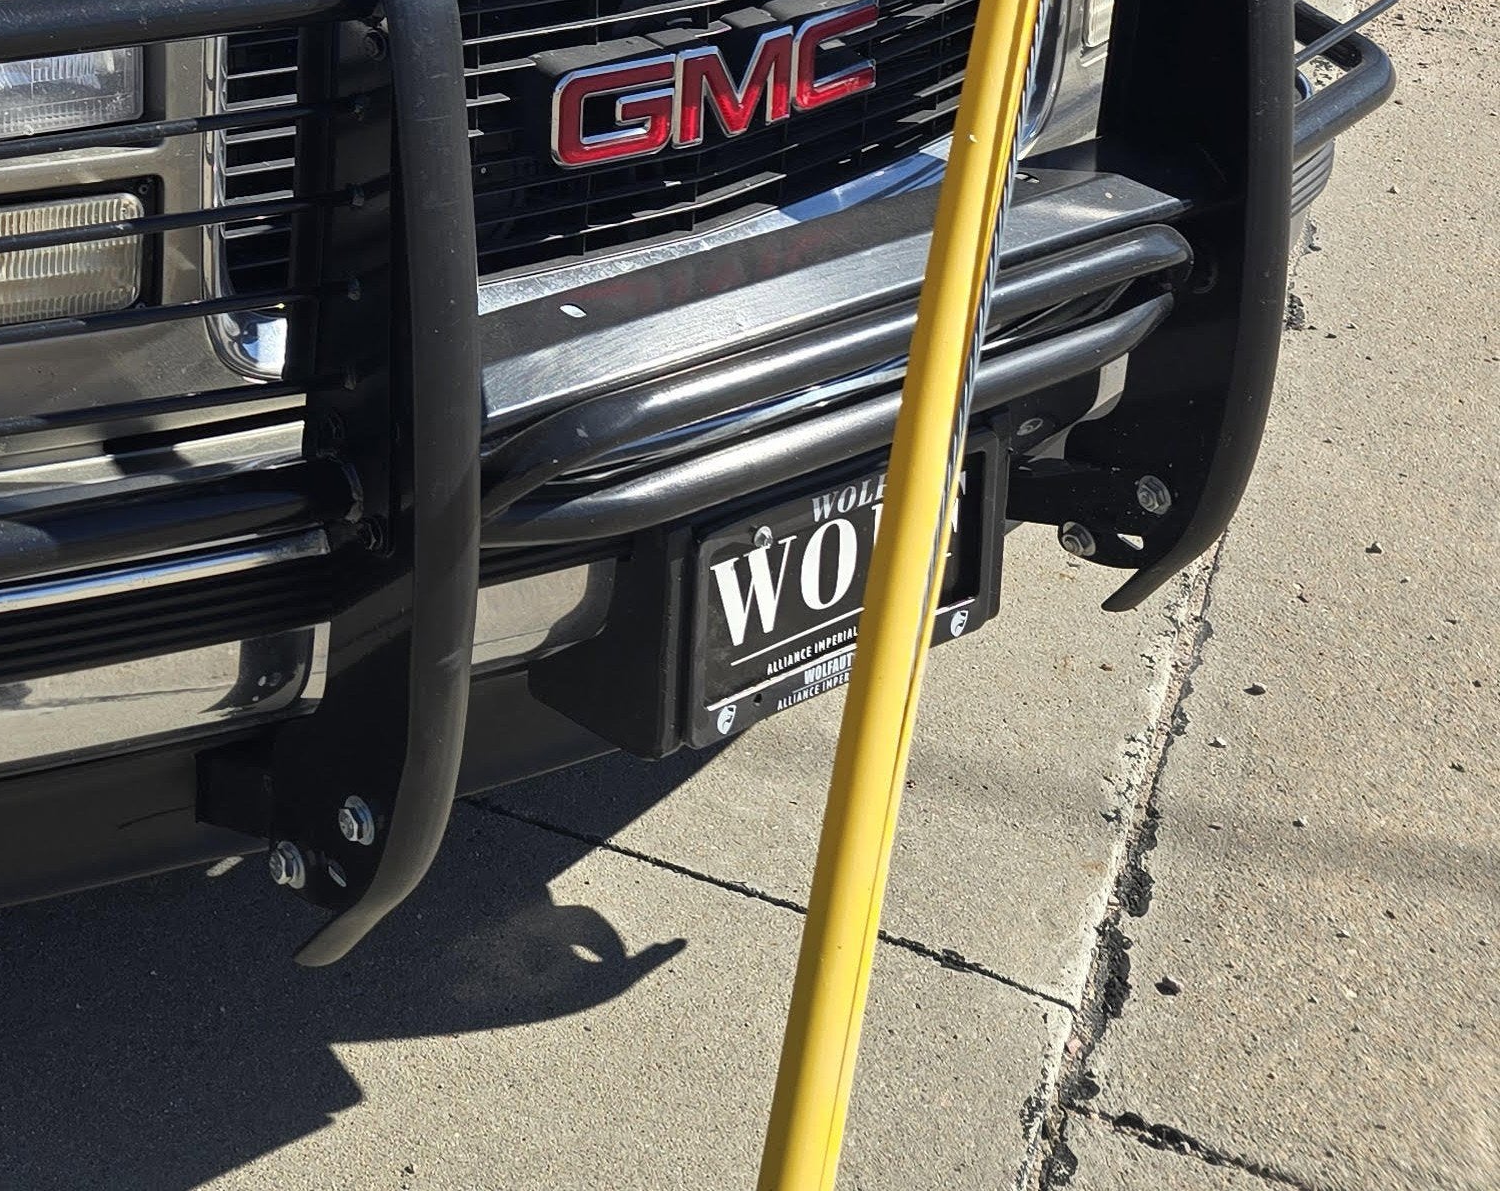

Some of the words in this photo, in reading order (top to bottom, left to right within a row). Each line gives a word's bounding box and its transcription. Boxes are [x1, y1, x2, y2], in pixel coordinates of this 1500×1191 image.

[766, 646, 812, 676] ALLIANCE
[814, 625, 859, 654] IMPERIAL
[777, 684, 820, 711] ALLIANCE
